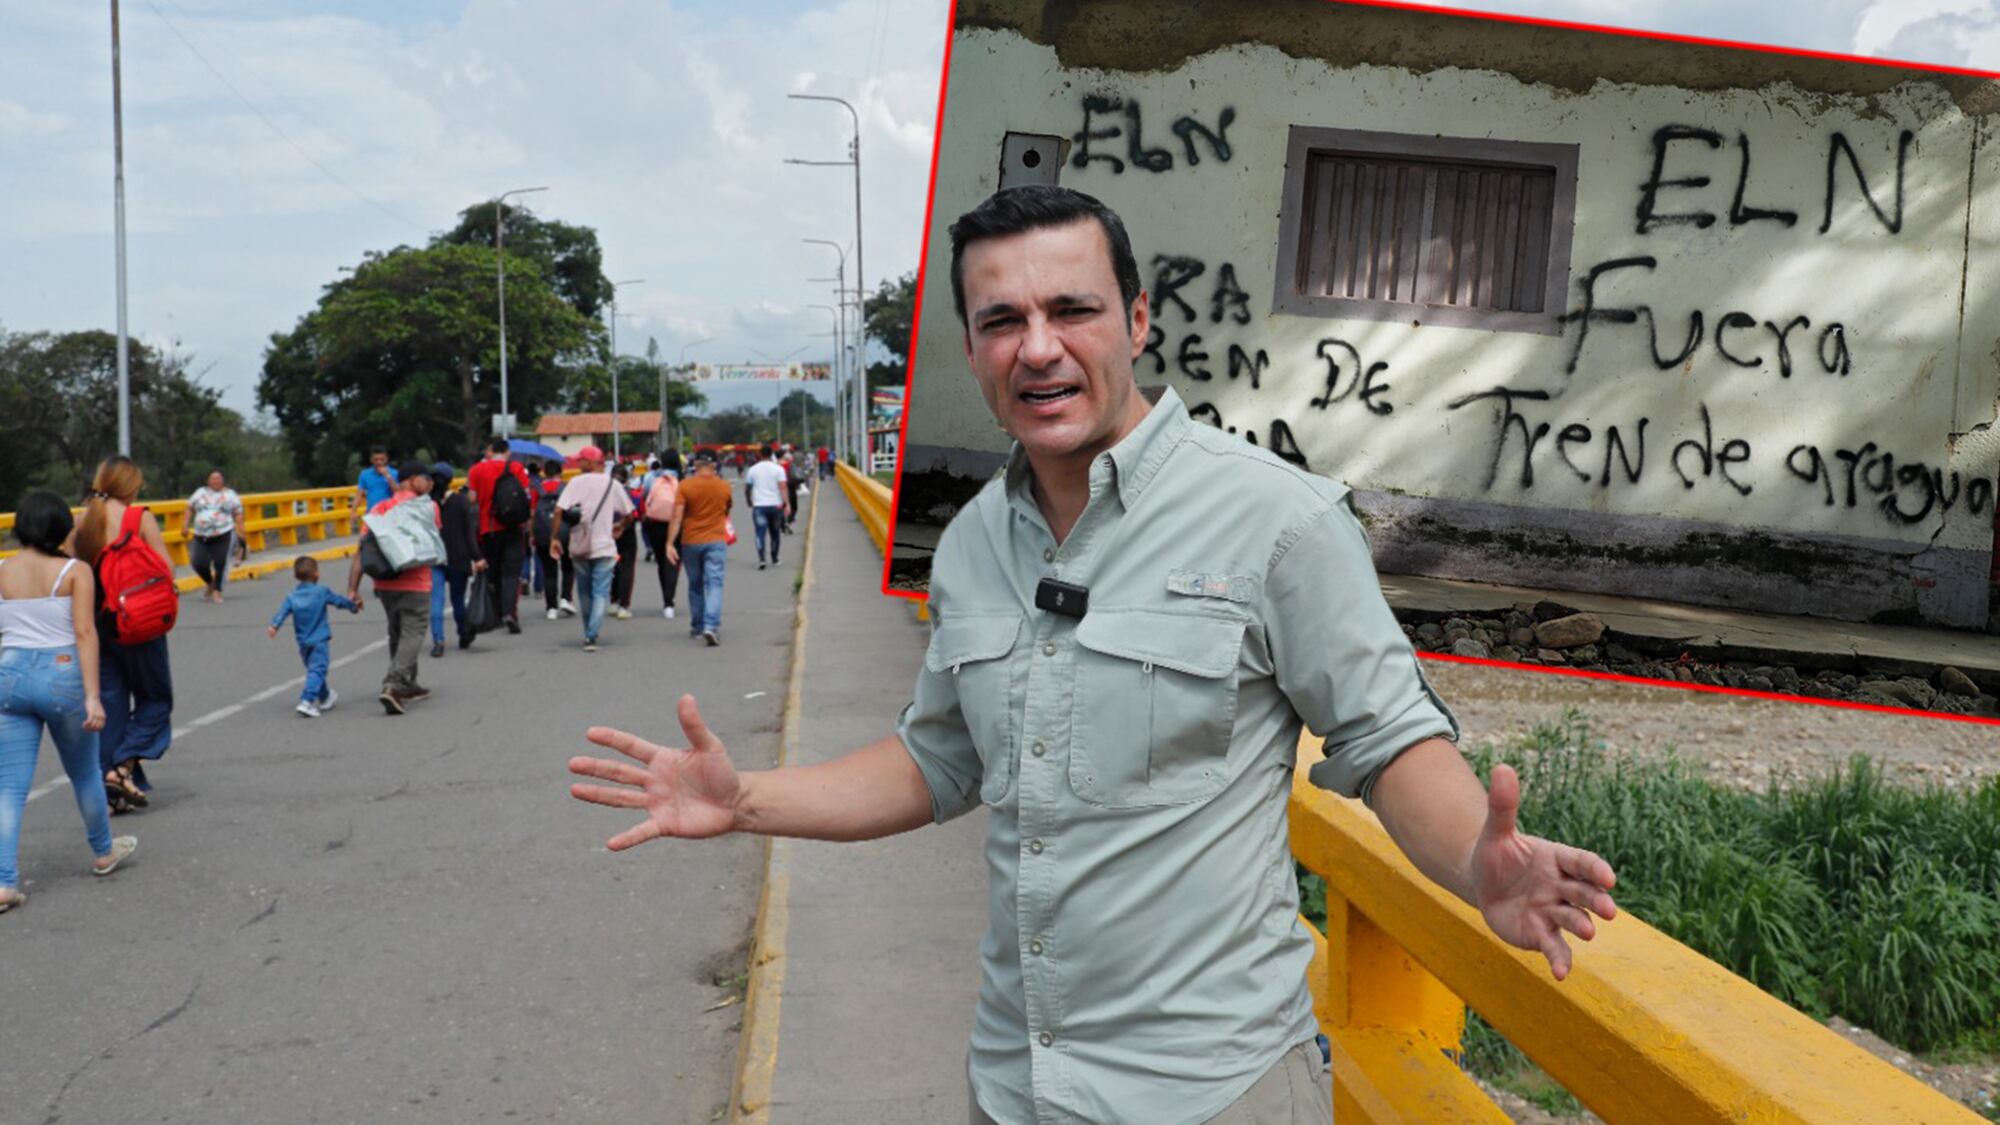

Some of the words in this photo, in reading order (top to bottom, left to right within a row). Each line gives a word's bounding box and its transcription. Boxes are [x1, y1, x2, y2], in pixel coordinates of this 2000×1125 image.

[1073, 94, 1236, 174] ELN
[1636, 123, 1913, 235] ELN
[1557, 255, 1850, 379] Fuera
[1134, 325, 1270, 390] REN
[1310, 338, 1393, 416] DE
[1671, 400, 1752, 496] de
